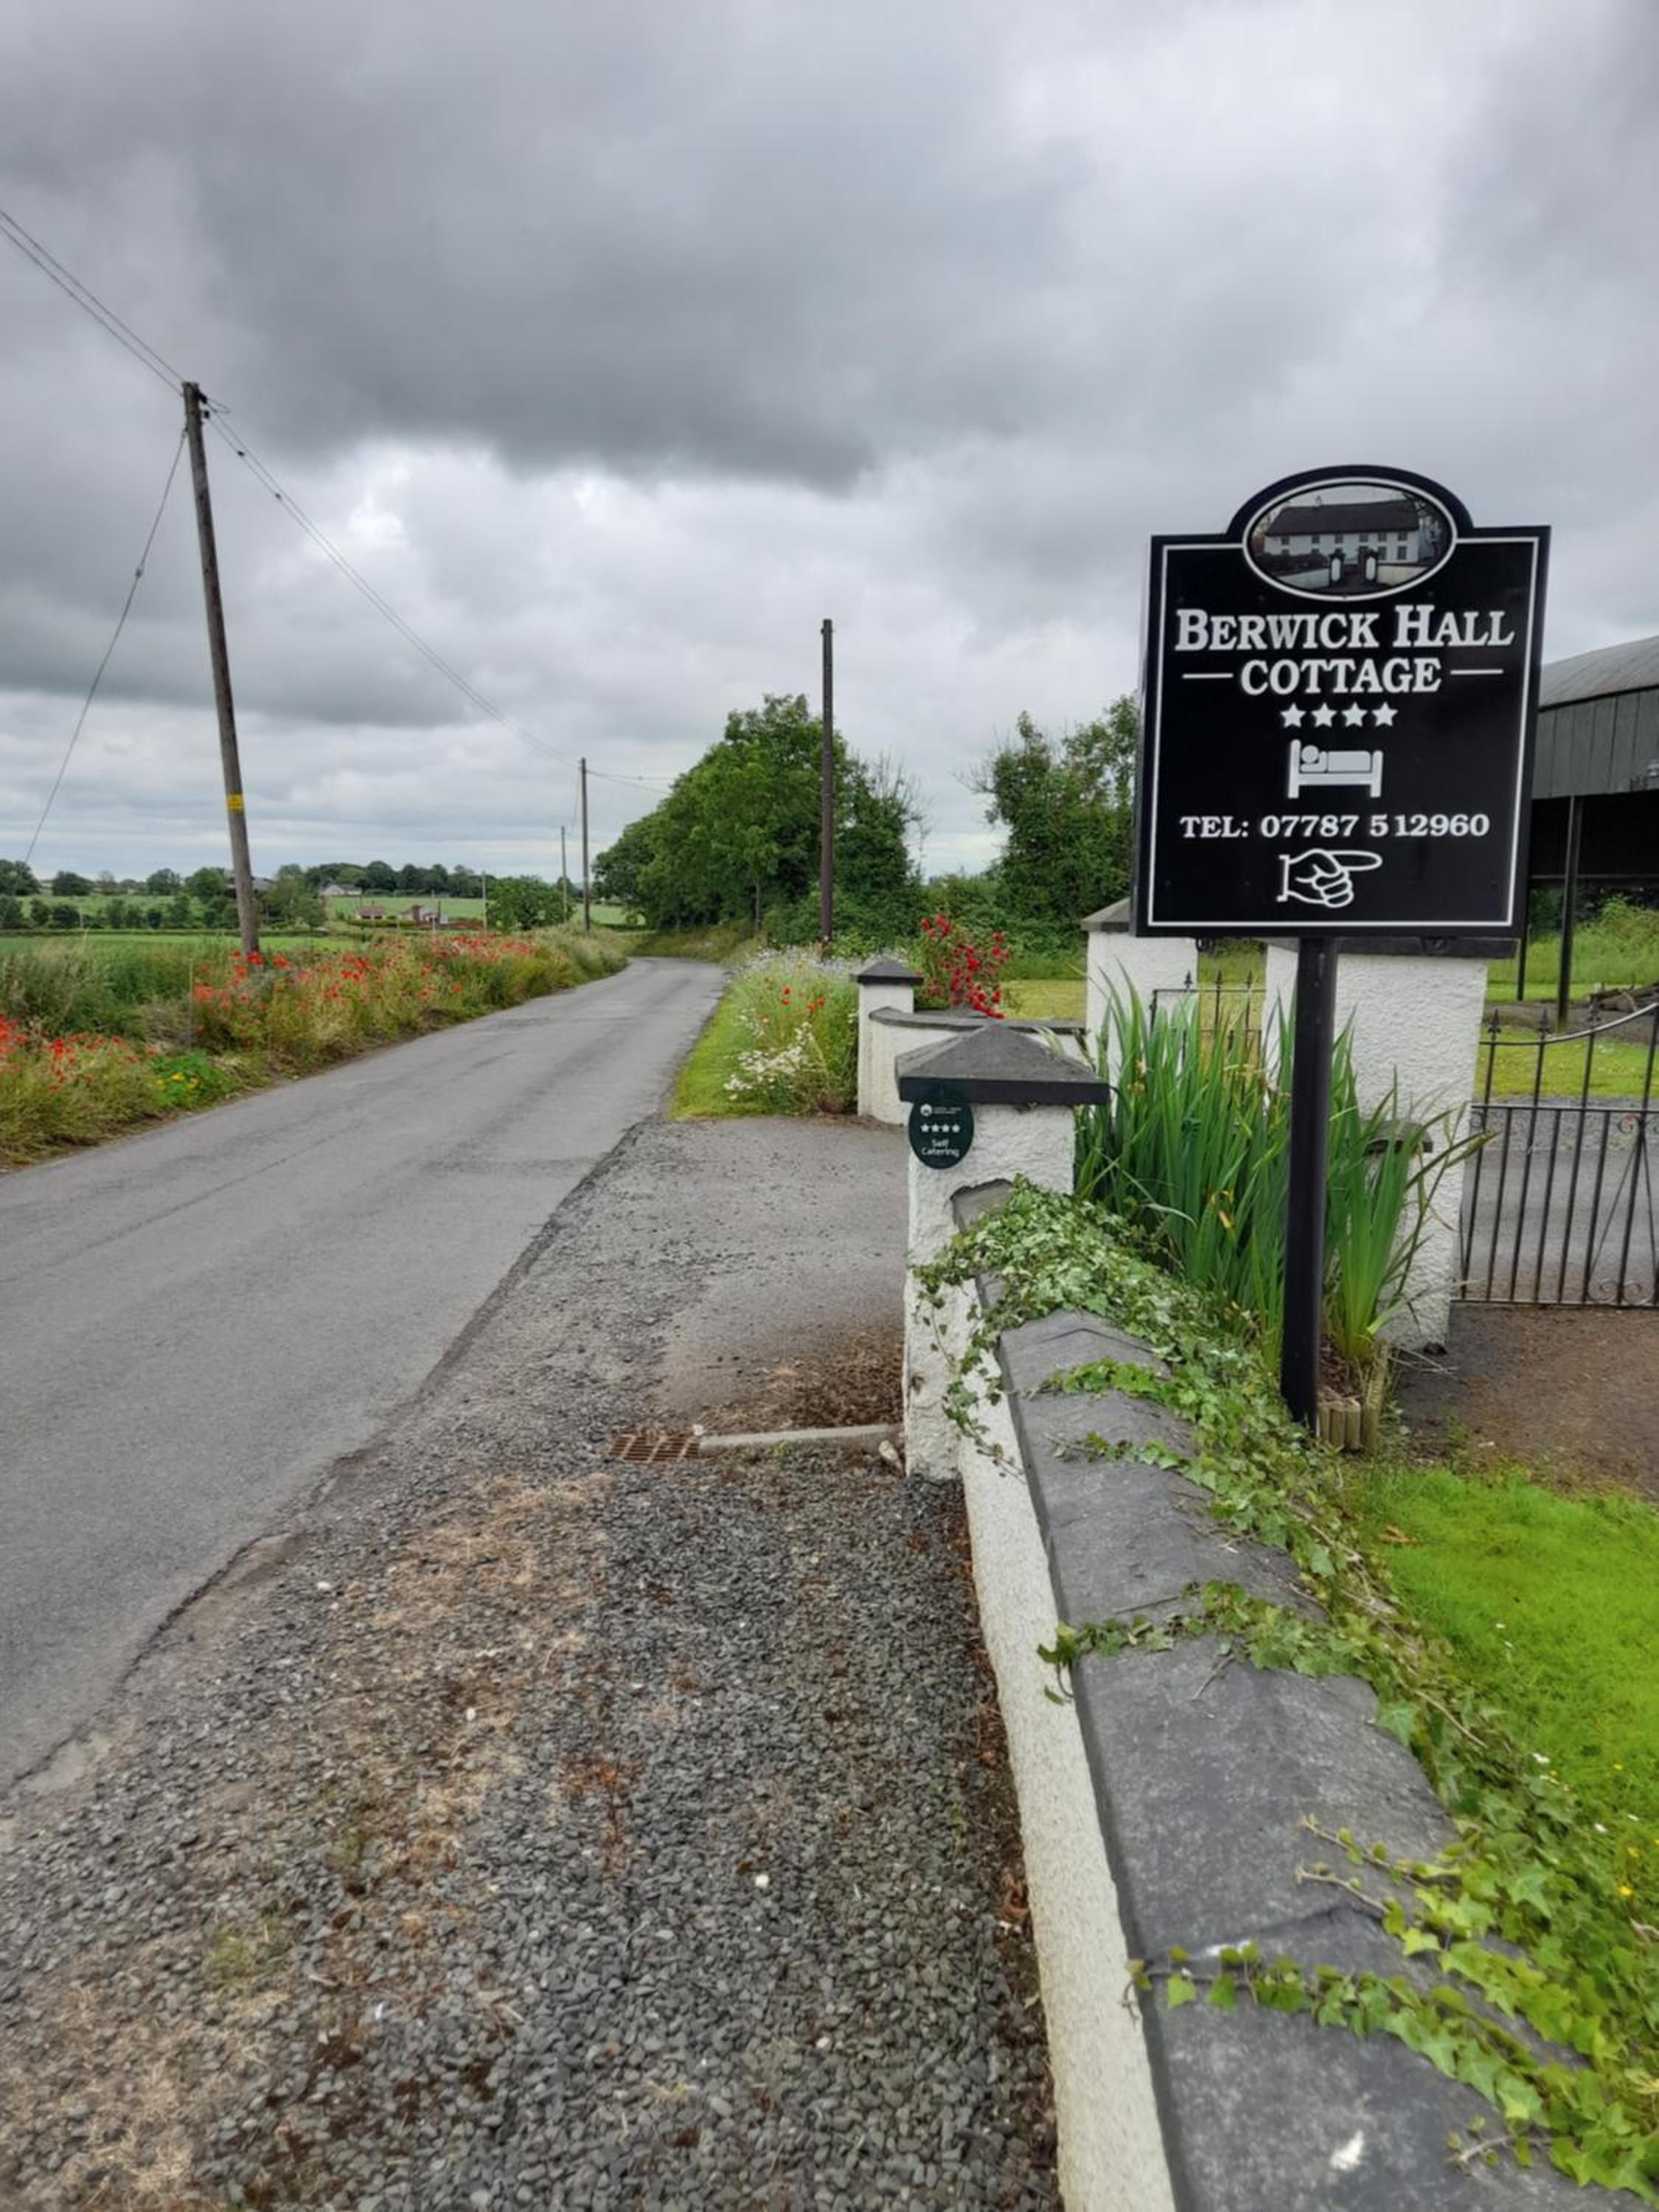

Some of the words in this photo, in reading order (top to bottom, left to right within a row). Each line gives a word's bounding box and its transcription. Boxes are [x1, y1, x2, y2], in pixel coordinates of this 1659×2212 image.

[1175, 608, 1380, 651] BERWICK
[1394, 605, 1515, 648] HALL
[1241, 658, 1441, 695] COTTAGE
[1180, 816, 1249, 838] TEL:
[1261, 815, 1358, 838] 07787
[1370, 814, 1490, 838] 512960
[921, 1147, 960, 1158] Catering
[932, 1138, 949, 1147] Self
